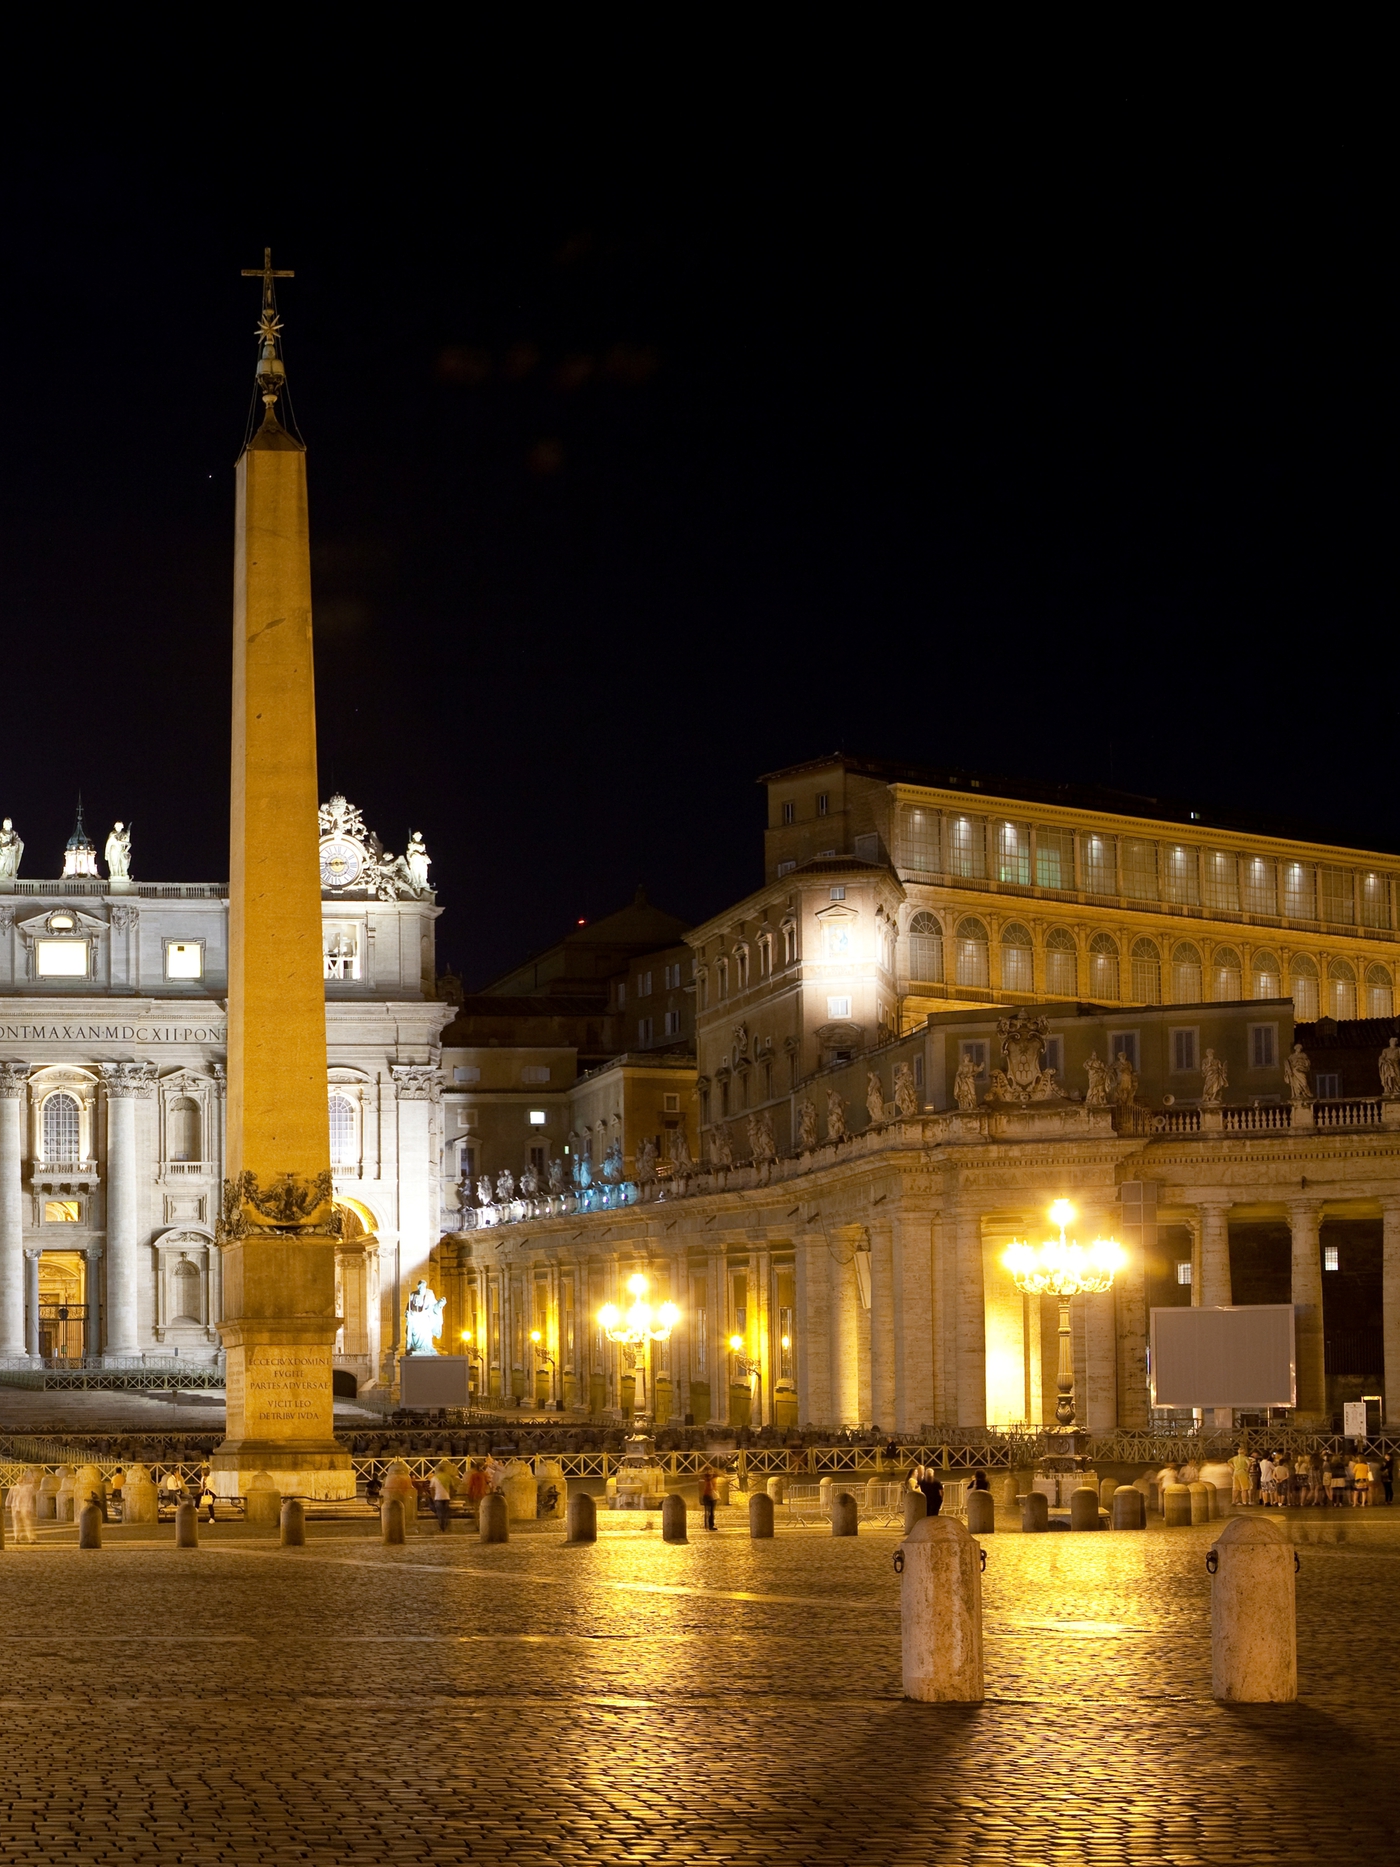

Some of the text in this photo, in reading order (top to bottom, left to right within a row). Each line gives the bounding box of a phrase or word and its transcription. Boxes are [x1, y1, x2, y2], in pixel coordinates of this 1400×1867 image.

[32, 1025, 72, 1039] MAX
[75, 1025, 101, 1040] AN
[105, 1025, 178, 1041] MDCXII
[294, 1358, 329, 1366] DOMINI
[274, 1370, 305, 1378] FVGITE
[250, 1382, 329, 1390] PARTES ADVERSAE
[267, 1400, 311, 1408] VICIT LEO
[259, 1412, 270, 1420] DE
[297, 1412, 319, 1420] IVDA
